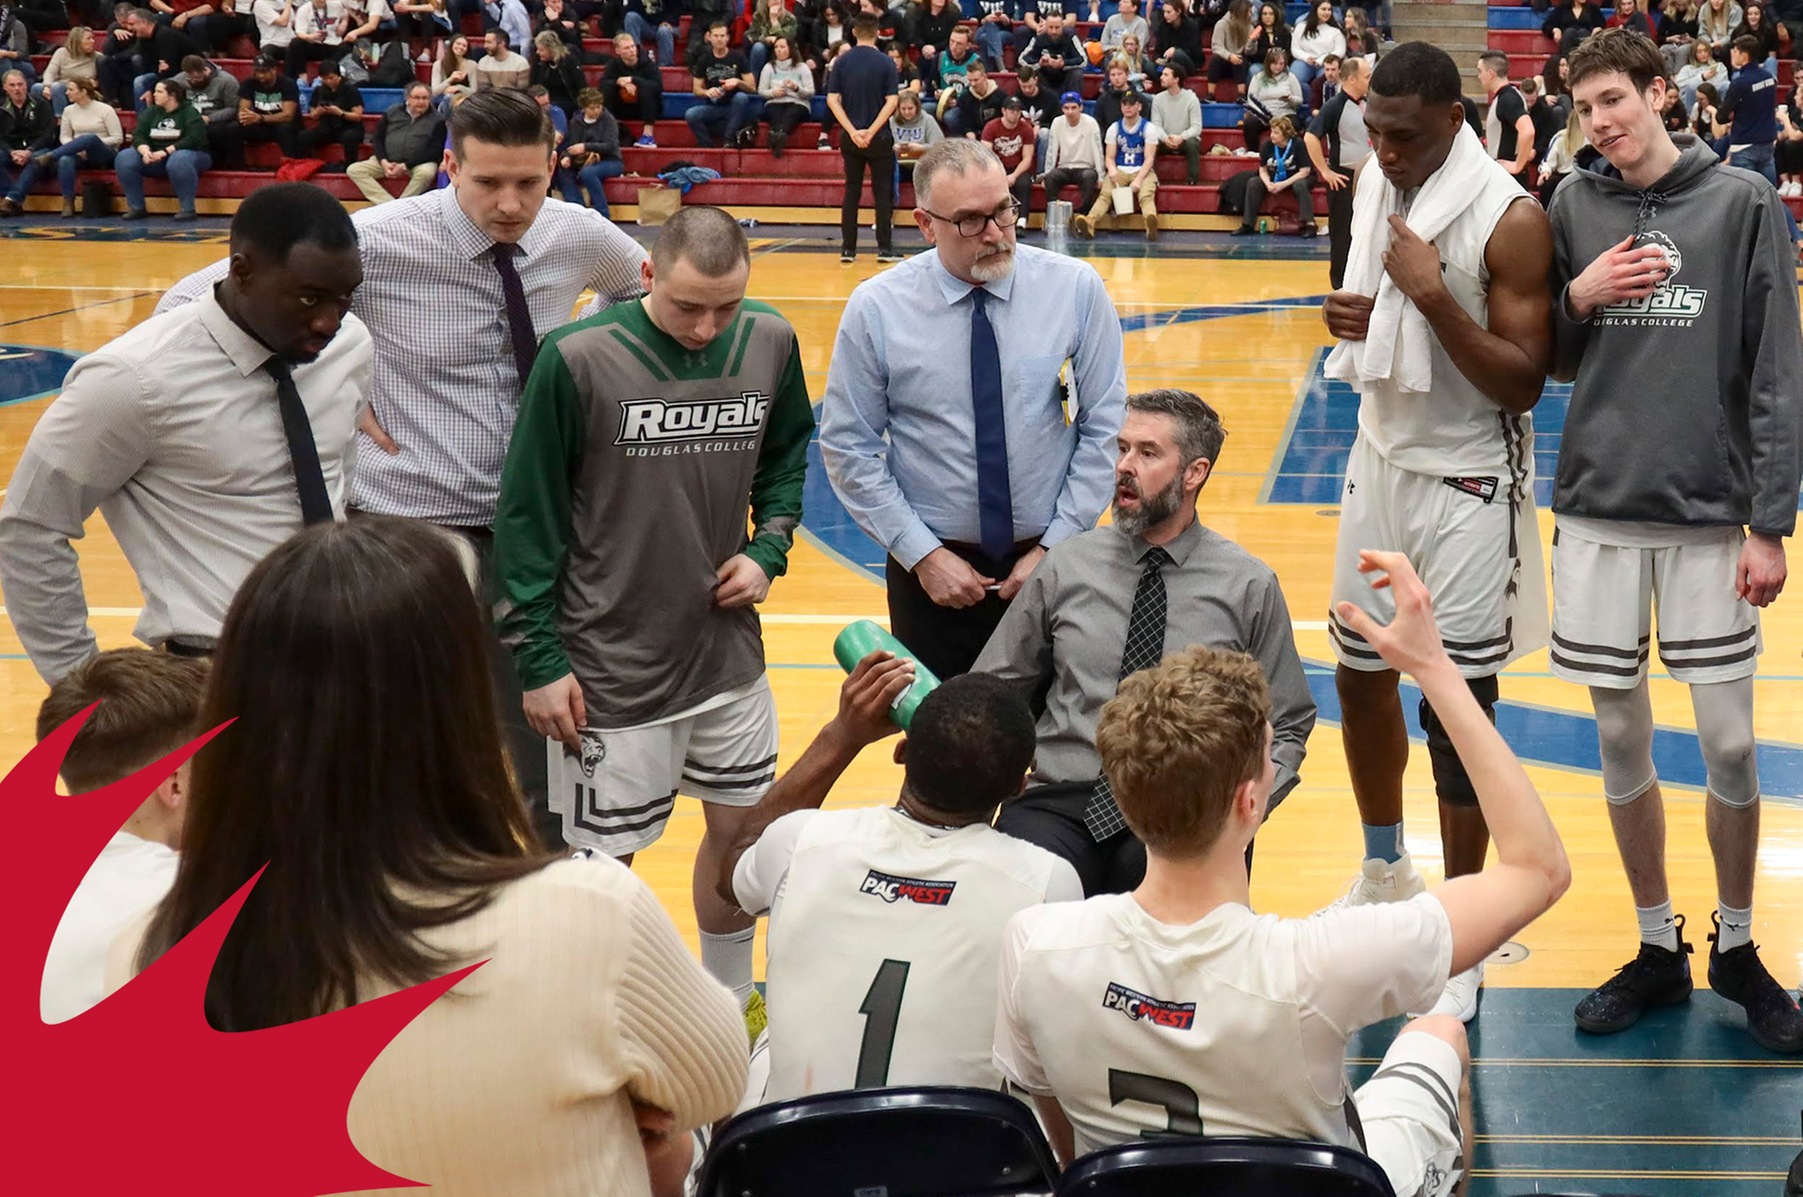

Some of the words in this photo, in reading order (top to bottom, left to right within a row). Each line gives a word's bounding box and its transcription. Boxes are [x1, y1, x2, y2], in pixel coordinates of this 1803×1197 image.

[895, 127, 922, 141] VIU
[1641, 318, 1694, 327] COLLEGE
[626, 443, 701, 457] DOUGLAS
[704, 440, 756, 452] COLLEG
[854, 958, 911, 1090] 1
